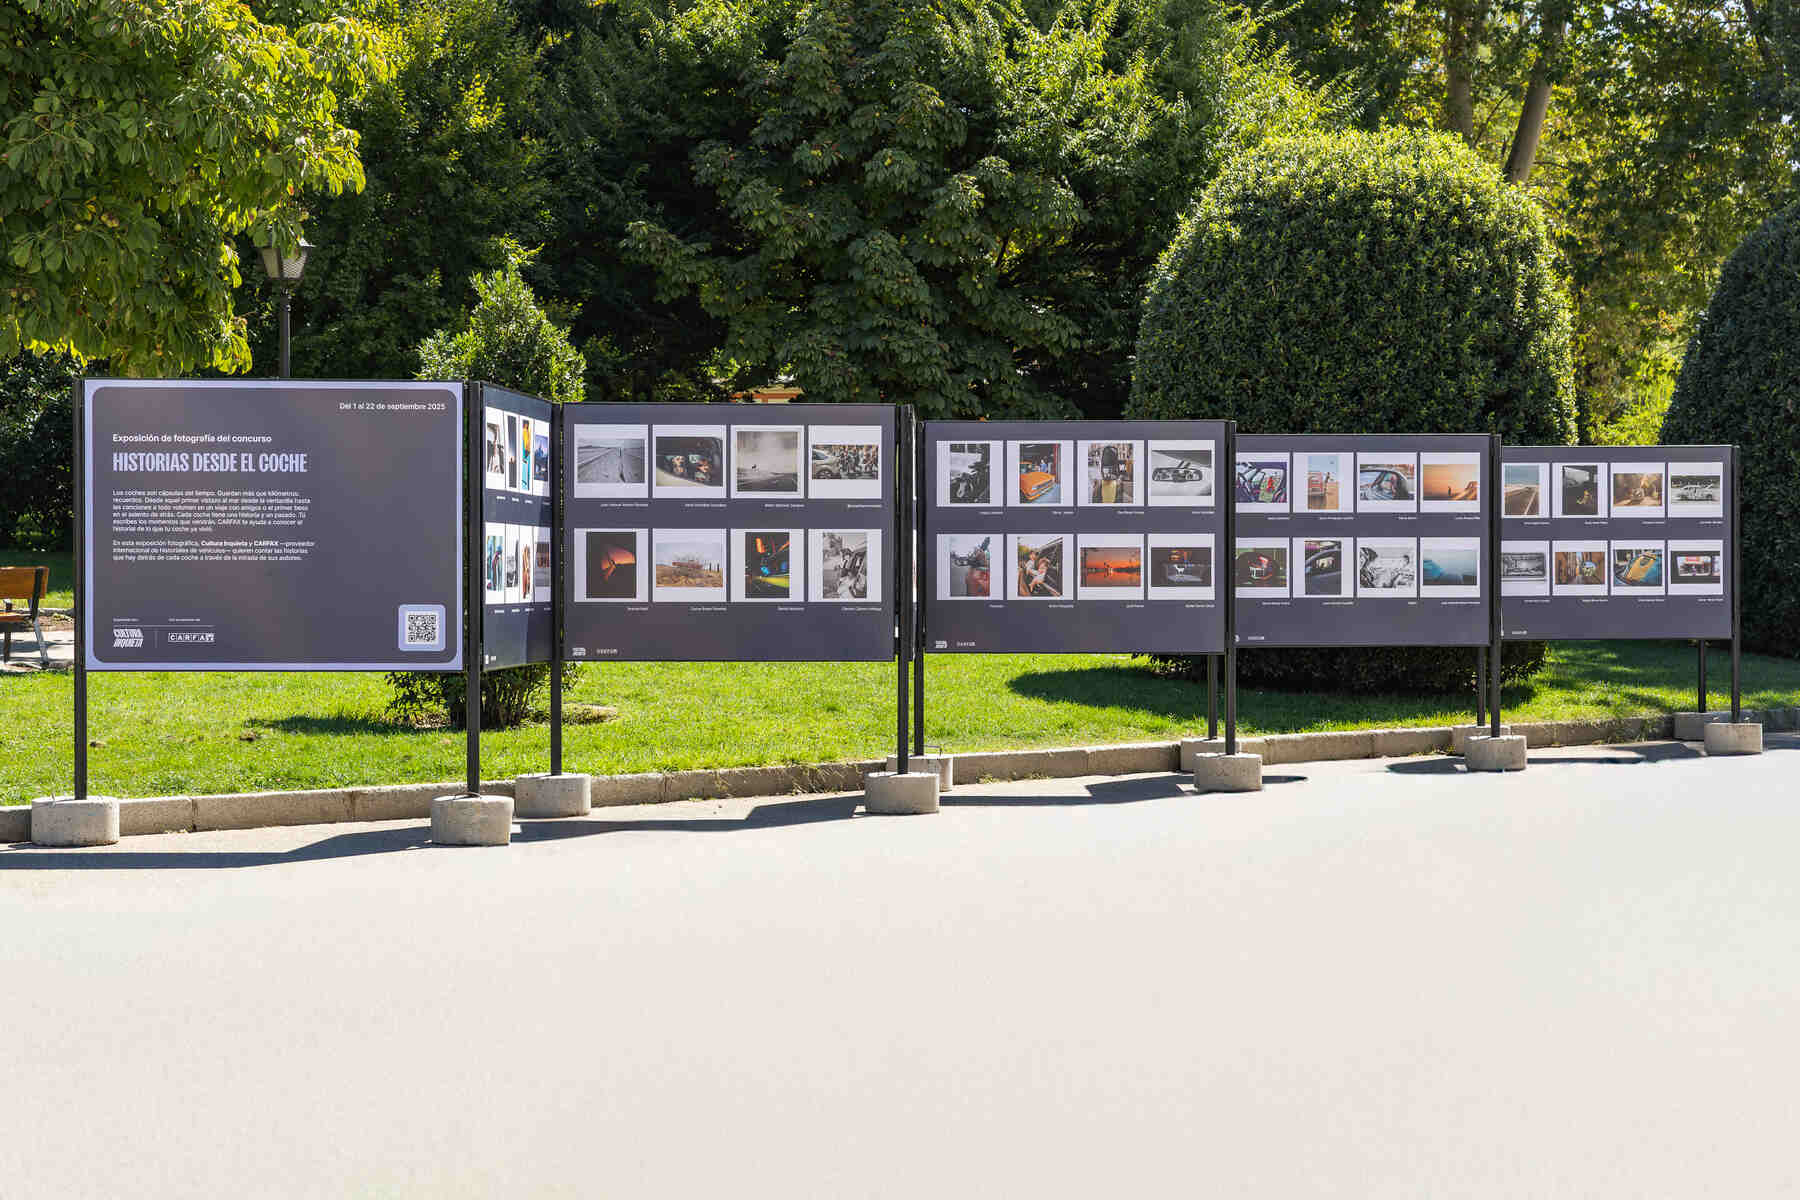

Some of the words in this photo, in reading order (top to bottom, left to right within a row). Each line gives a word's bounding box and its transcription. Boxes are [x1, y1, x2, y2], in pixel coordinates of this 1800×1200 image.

[339, 402, 351, 410] Del
[366, 402, 375, 410] 22
[376, 402, 386, 410] de
[387, 402, 426, 412] septiembre
[427, 402, 446, 410] 2025
[112, 433, 160, 444] Exposición
[161, 433, 172, 442] de
[173, 433, 216, 444] fotografía
[217, 433, 230, 442] del
[112, 452, 189, 473] HISTORIAS
[192, 452, 239, 473] DESDE
[240, 452, 257, 473] EL
[258, 452, 308, 473] COCHE
